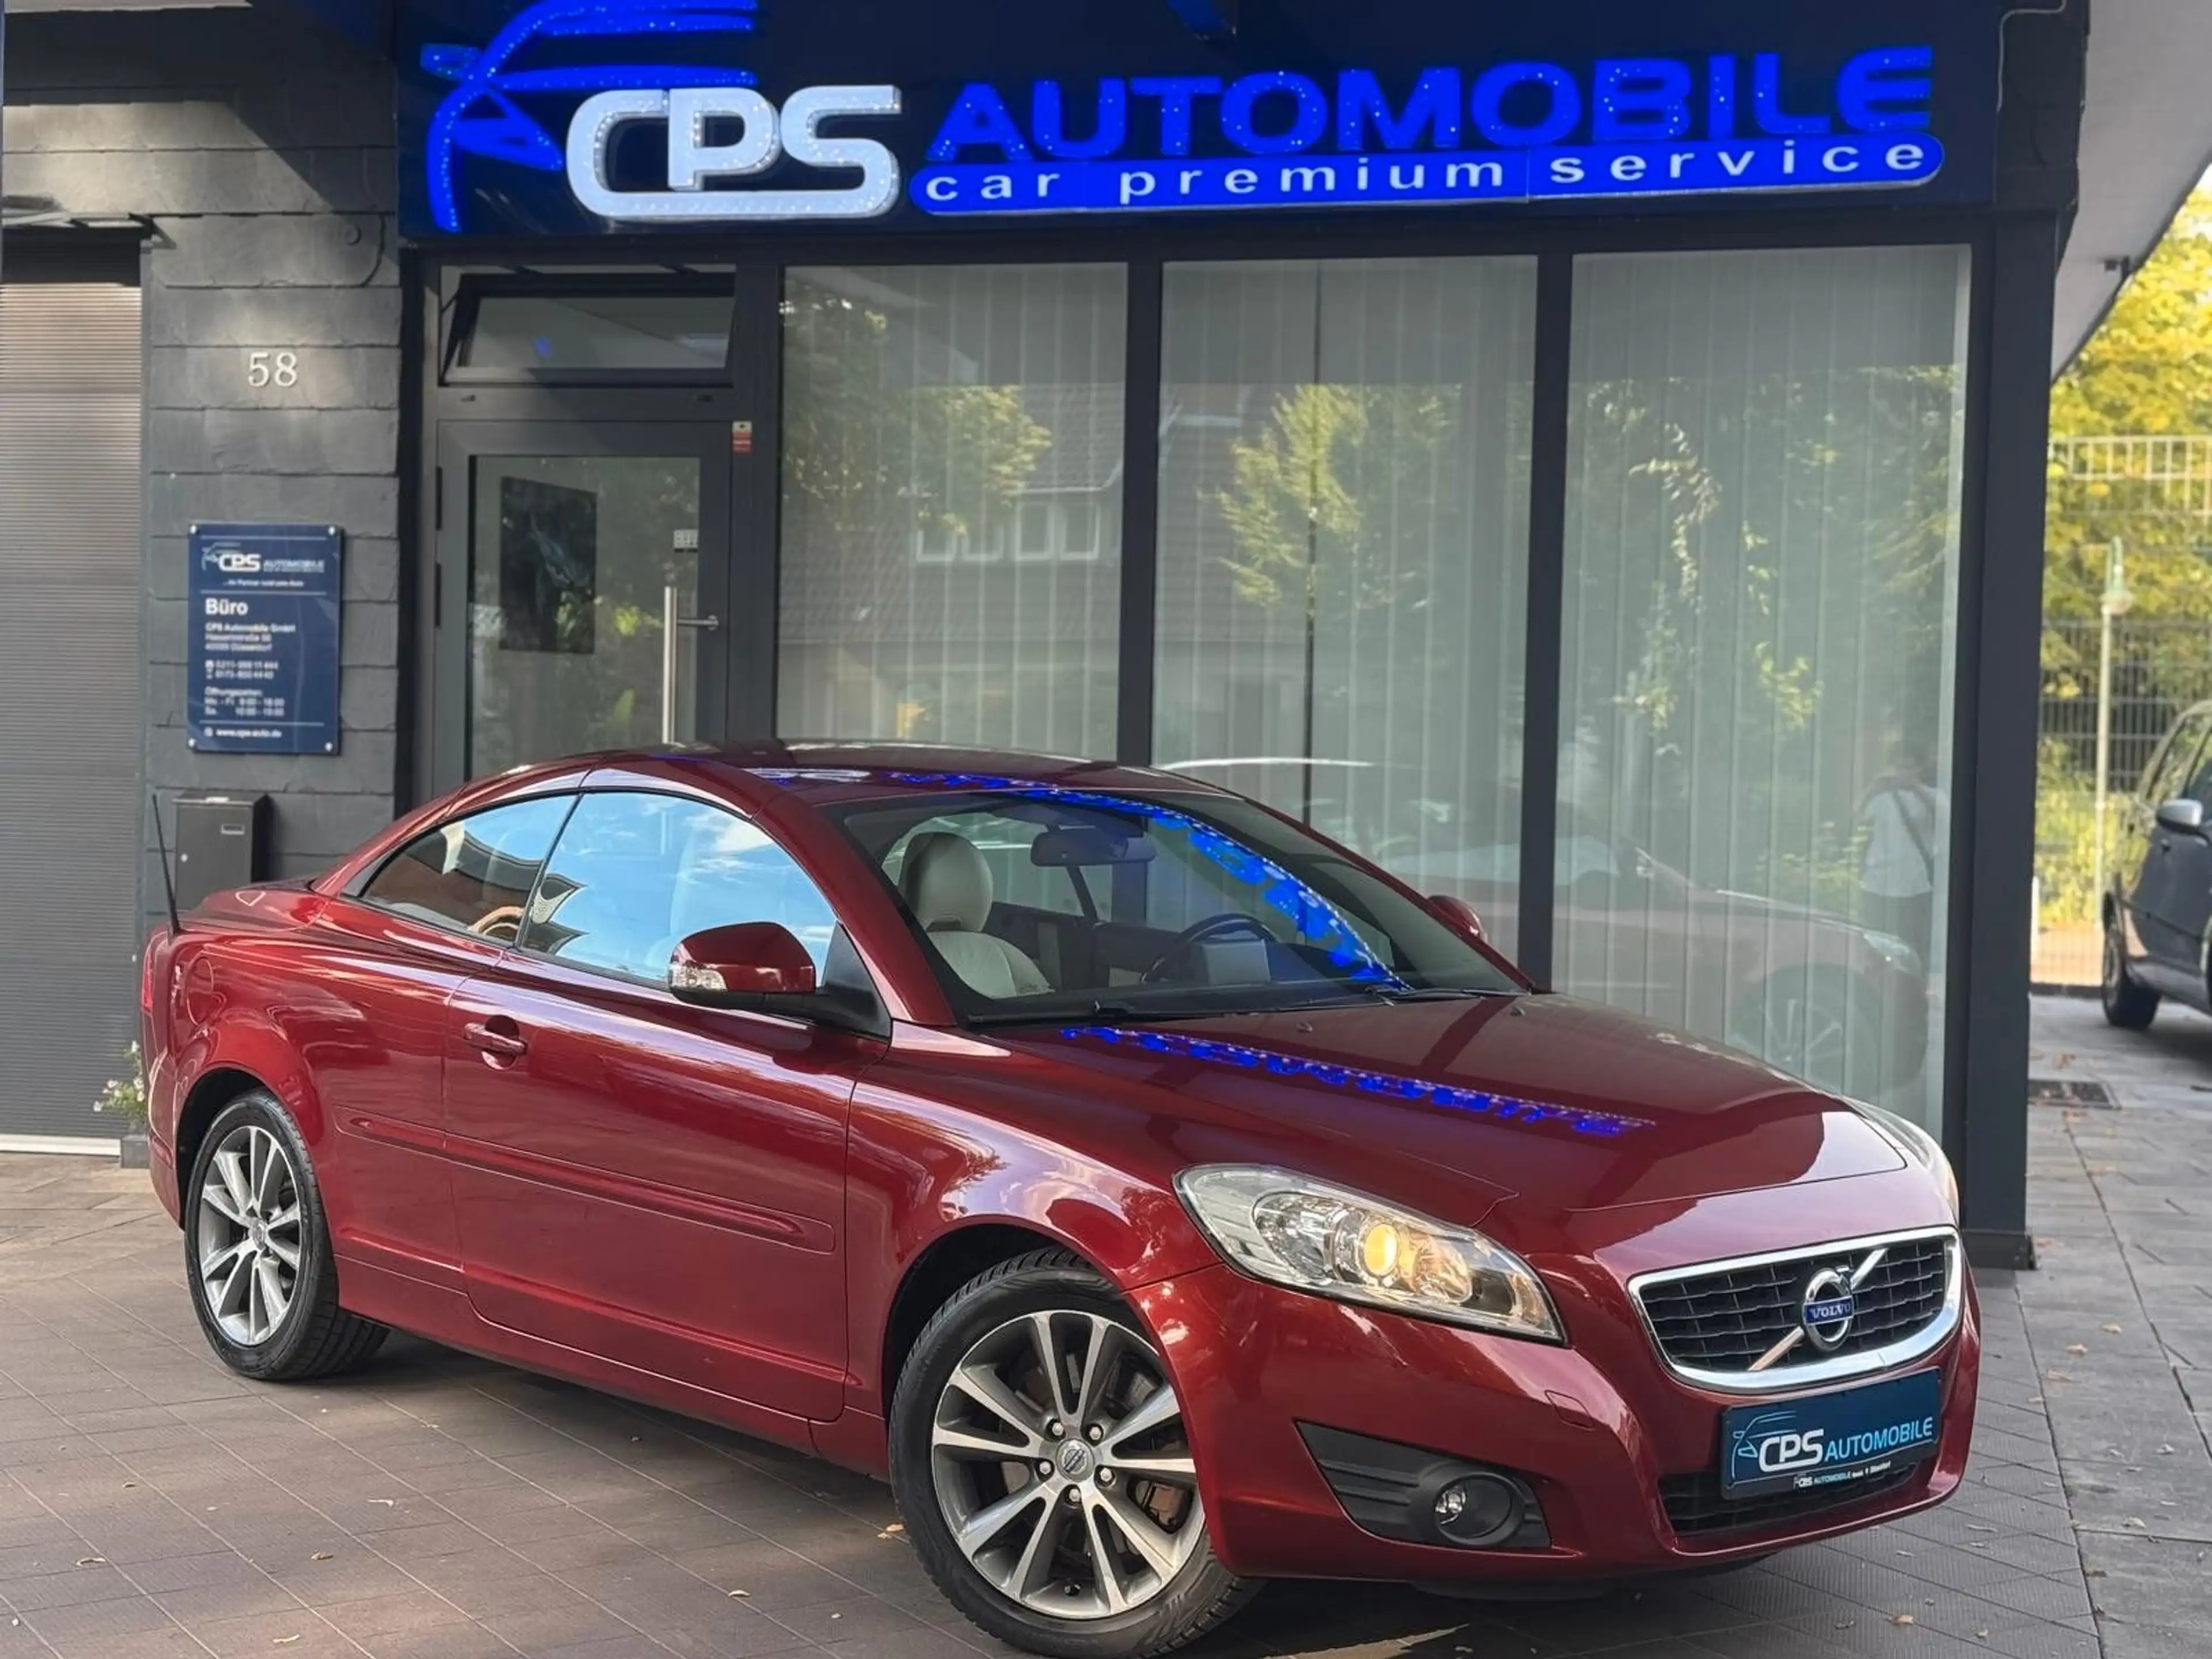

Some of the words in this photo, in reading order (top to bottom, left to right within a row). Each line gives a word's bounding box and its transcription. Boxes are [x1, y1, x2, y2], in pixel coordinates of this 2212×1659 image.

[566, 85, 902, 219] CPS
[925, 45, 1933, 161] AUTOMOBILE
[926, 170, 1060, 202] car
[1119, 157, 1503, 205] premium
[1550, 139, 1925, 184] service
[248, 351, 298, 387] 58
[218, 553, 262, 572] CPS
[205, 597, 249, 616] Büro
[1809, 1302, 1851, 1319] VOLVO
[1759, 1429, 1824, 1472] CPS
[1825, 1416, 1933, 1462] AUTOMOBILE
